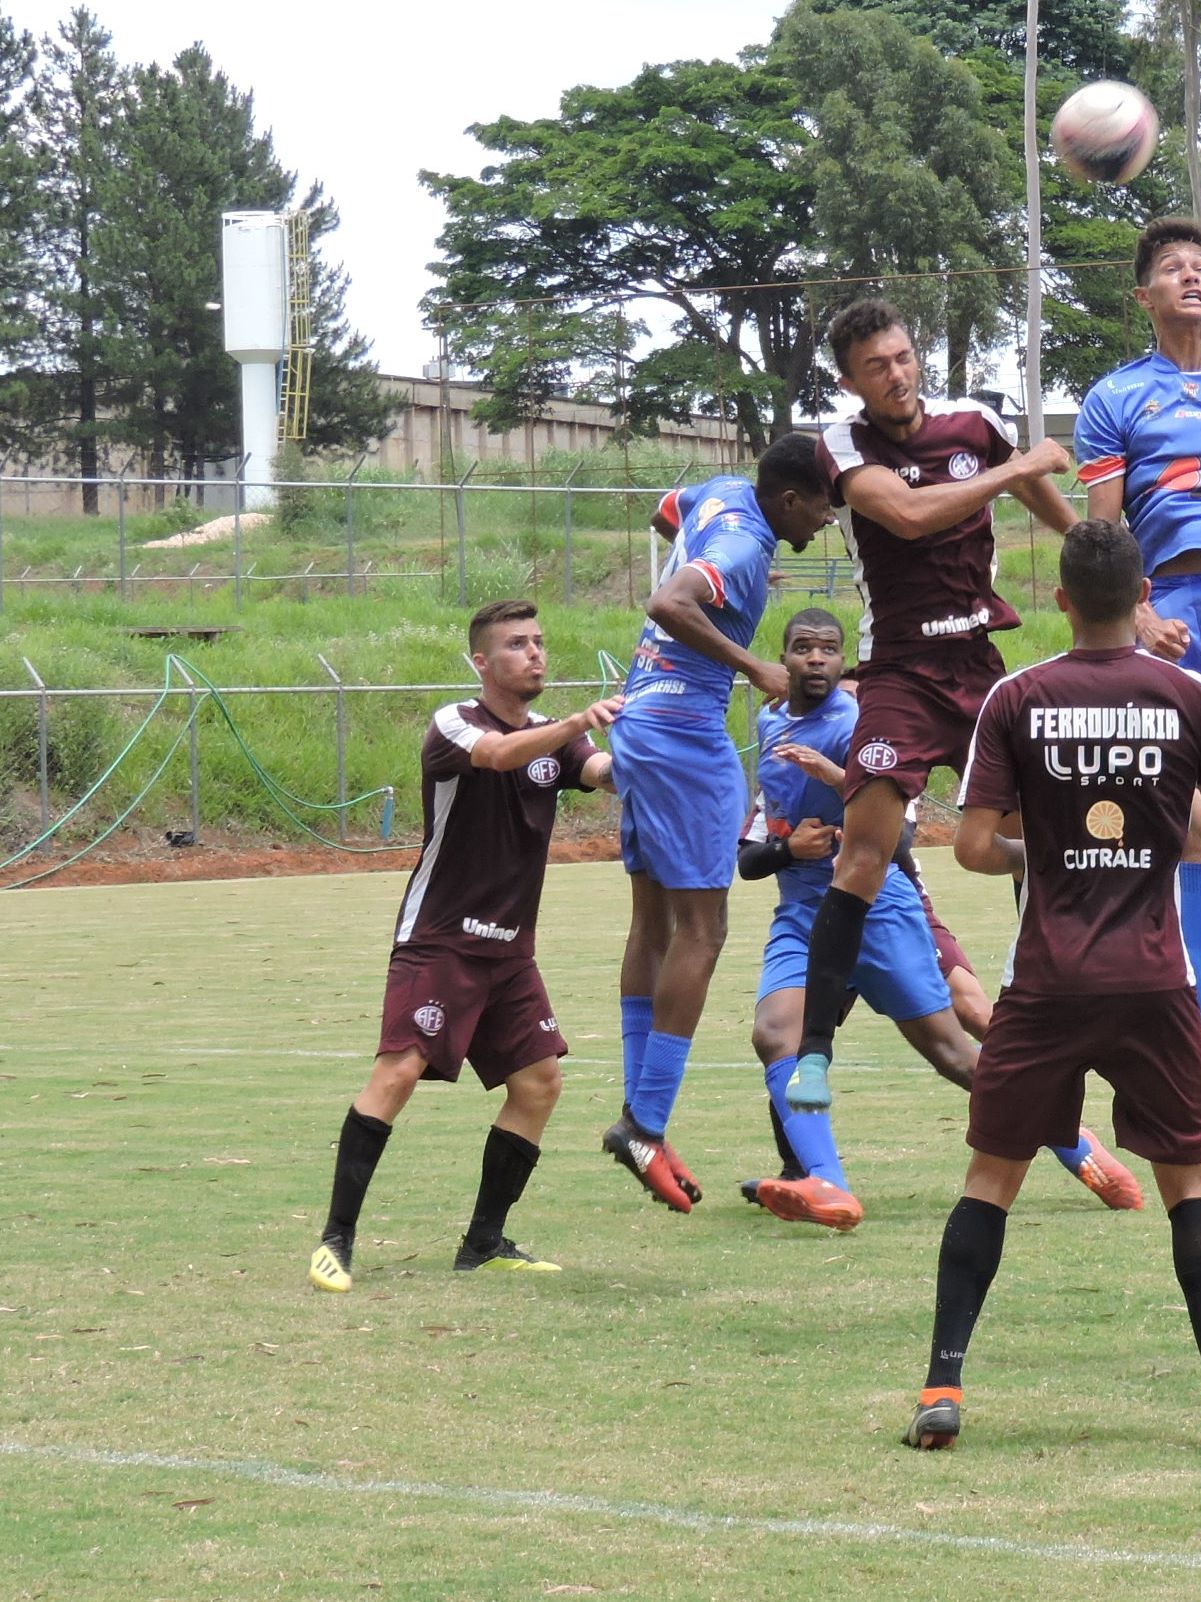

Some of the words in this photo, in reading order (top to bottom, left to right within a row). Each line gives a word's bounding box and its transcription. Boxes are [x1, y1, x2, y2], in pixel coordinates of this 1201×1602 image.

[921, 607, 990, 637] Unimed
[1030, 702, 1180, 740] FERROVIÁRIA
[861, 746, 892, 767] AFE
[1044, 745, 1162, 780] LUPO
[531, 761, 557, 780] AFE
[1080, 776, 1160, 787] SPORT
[1063, 848, 1152, 870] CUTRALE
[417, 1008, 442, 1028] AFE
